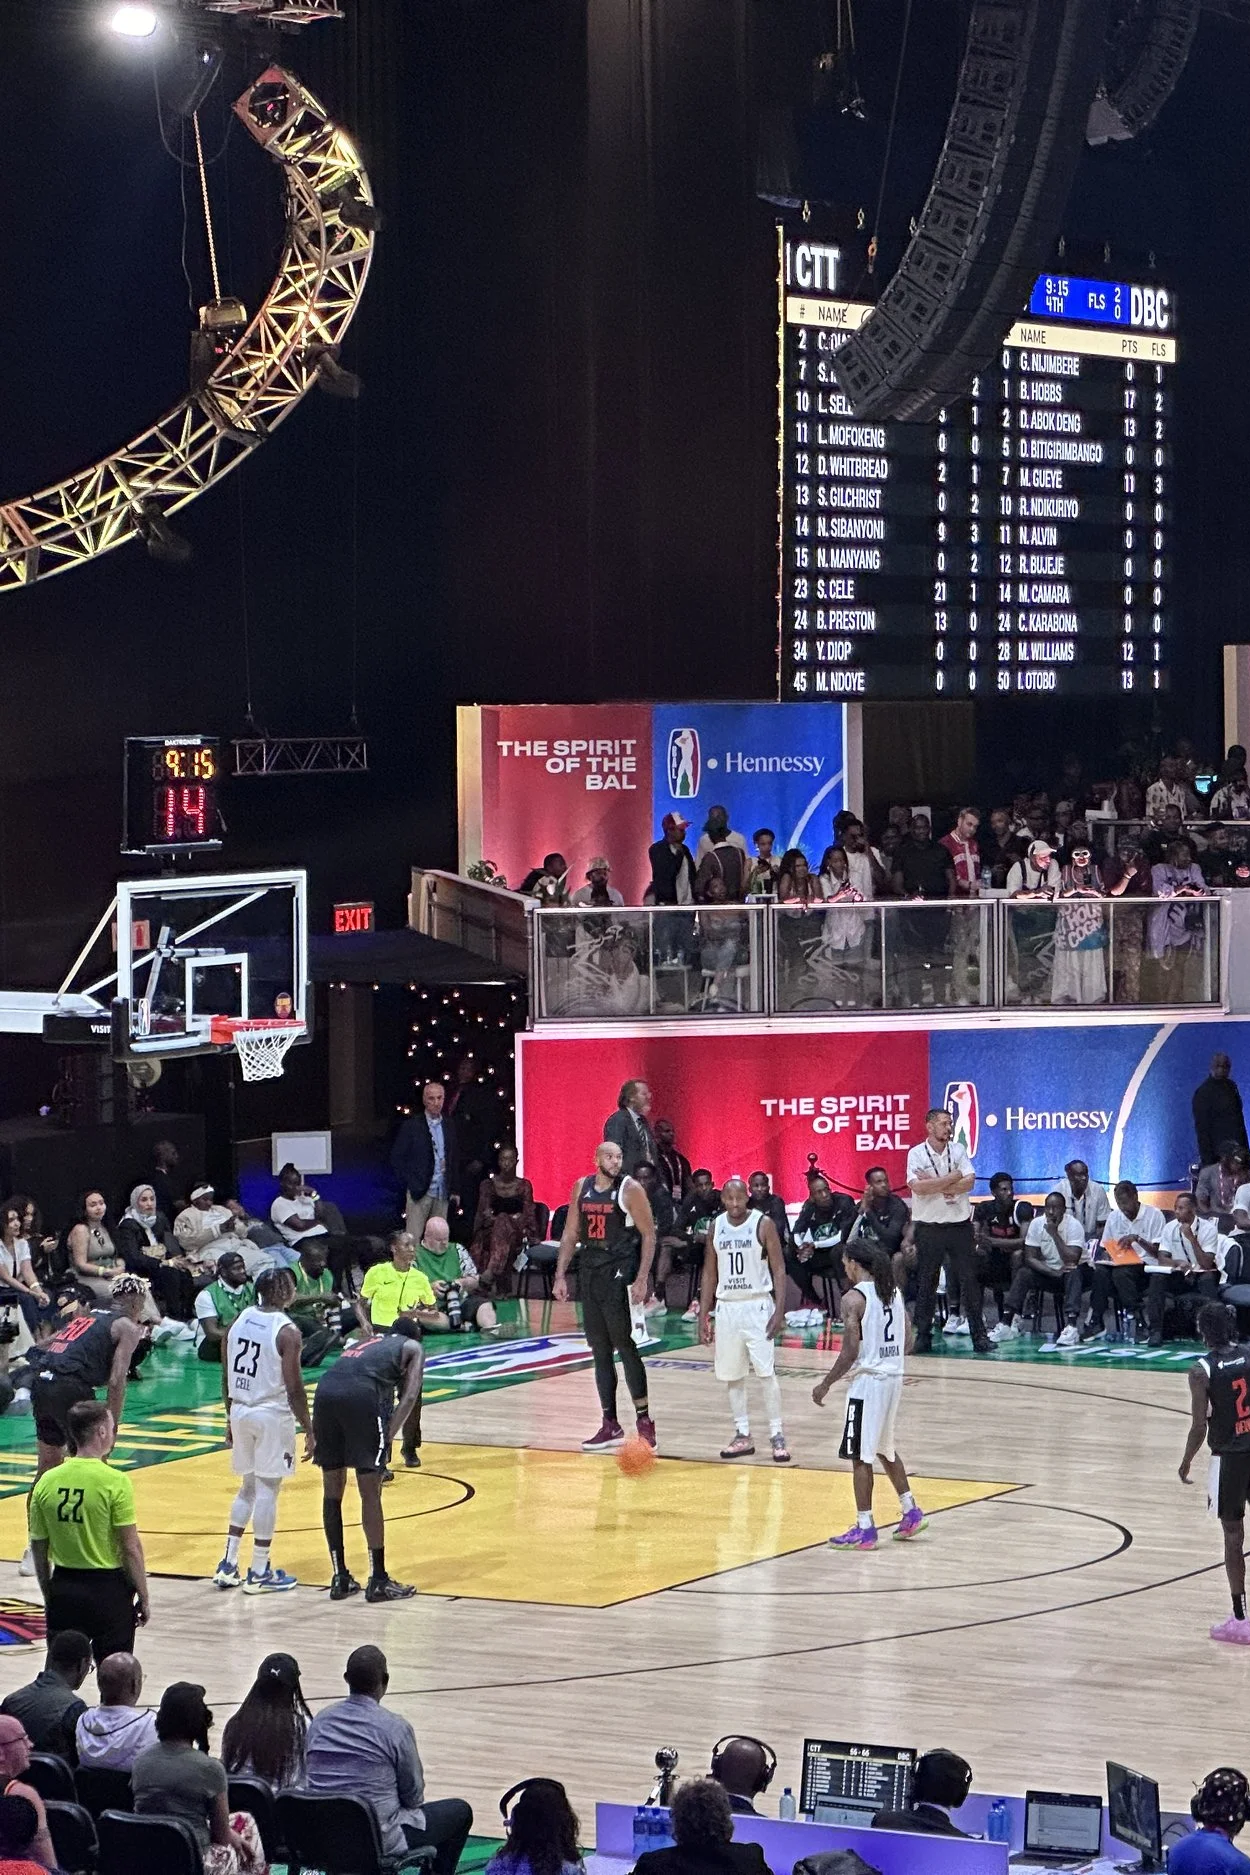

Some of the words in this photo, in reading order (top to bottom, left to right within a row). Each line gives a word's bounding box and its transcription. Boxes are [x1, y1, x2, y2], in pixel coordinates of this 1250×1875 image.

[796, 244, 840, 290] CTT
[819, 306, 847, 323] NAME
[1045, 279, 1069, 297] 9:15
[1089, 293, 1105, 310] FLS
[1130, 287, 1169, 329] DBC
[1046, 296, 1064, 313] 4TH
[1021, 328, 1046, 344] NAME
[1122, 340, 1138, 353] PTS
[1152, 342, 1166, 357] FLS
[1021, 353, 1030, 371] G.
[1031, 354, 1080, 376] NIJIMBERE
[1021, 381, 1030, 400] B.
[1032, 383, 1062, 402] HOBBS
[1124, 390, 1135, 409] 17
[1020, 409, 1029, 429] D.
[1031, 411, 1055, 431] ABOK
[1057, 412, 1080, 433] DENG
[1124, 420, 1135, 436] 13
[796, 422, 808, 443] 11
[818, 424, 828, 445] L.
[830, 425, 885, 448] MOFOKENG
[1020, 439, 1029, 458] D.
[796, 454, 809, 475] 12
[818, 455, 828, 476] D.
[830, 457, 888, 479] WHITBREAD
[1020, 468, 1031, 487] M.
[1033, 469, 1063, 489] GUEYE
[1124, 475, 1135, 493] 11
[796, 485, 809, 505] 13
[818, 487, 828, 506] S.
[830, 488, 881, 508] GILCHRIST
[1000, 497, 1012, 515] 10
[1020, 498, 1029, 516] R.
[1031, 499, 1078, 518] NDIKURIYO
[795, 516, 809, 536] 14
[818, 518, 829, 537] N.
[830, 518, 884, 540] SIBANYONI
[1000, 526, 1011, 544] 11
[1020, 526, 1030, 545] N.
[1031, 527, 1057, 546] ALVIN
[795, 548, 808, 568] 15
[817, 548, 829, 568] N.
[830, 549, 880, 569] MANYANG
[999, 555, 1011, 574] 12
[1019, 555, 1029, 574] R.
[794, 579, 808, 599] 23
[817, 580, 828, 599] S.
[830, 580, 854, 599] CELE
[934, 582, 946, 602] 21
[999, 584, 1011, 602] 14
[1019, 584, 1030, 603] M.
[1031, 585, 1069, 604] CAMARA
[794, 610, 808, 629] 24
[817, 610, 827, 629] B.
[829, 611, 875, 631] PRESTON
[934, 612, 947, 631] 13
[998, 614, 1010, 632] 24
[1018, 614, 1028, 632] C.
[1029, 614, 1077, 632] KARABONA
[793, 641, 807, 660] 34
[816, 641, 826, 660] Y.
[828, 642, 852, 661] DIOP
[998, 642, 1010, 661] 28
[1018, 643, 1030, 661] M.
[1031, 643, 1074, 661] WILLIAMS
[1122, 643, 1133, 661] 12
[793, 672, 807, 691] 45
[816, 672, 829, 691] M.
[830, 672, 865, 691] NDOYE
[998, 672, 1009, 690] 50
[1026, 672, 1055, 690] OTOBO
[1122, 672, 1133, 689] 13
[497, 740, 549, 757] THE
[553, 739, 637, 756] SPIRIT
[166, 750, 215, 779] 9:15
[545, 757, 581, 774] OF
[586, 757, 637, 774] THE
[725, 752, 825, 777] Hennessy
[585, 775, 637, 790] BAL
[166, 787, 205, 837] 14
[334, 907, 372, 933] EXIT
[91, 1025, 111, 1034] VISIT
[760, 1098, 815, 1117] THE
[820, 1094, 910, 1115] SPIRIT
[812, 1115, 849, 1134] OF
[860, 1113, 910, 1132] THE
[1006, 1106, 1113, 1134] Hennessy
[855, 1132, 910, 1152] BAL
[719, 1240, 733, 1251] CAPE
[734, 1239, 752, 1249] TOWN
[728, 1251, 744, 1276] 10
[883, 1308, 895, 1343] 2
[233, 1338, 261, 1379] 23
[235, 1376, 251, 1392] CELE
[1231, 1377, 1250, 1418] 2
[847, 1404, 856, 1455] BAL
[57, 1487, 84, 1524] 22
